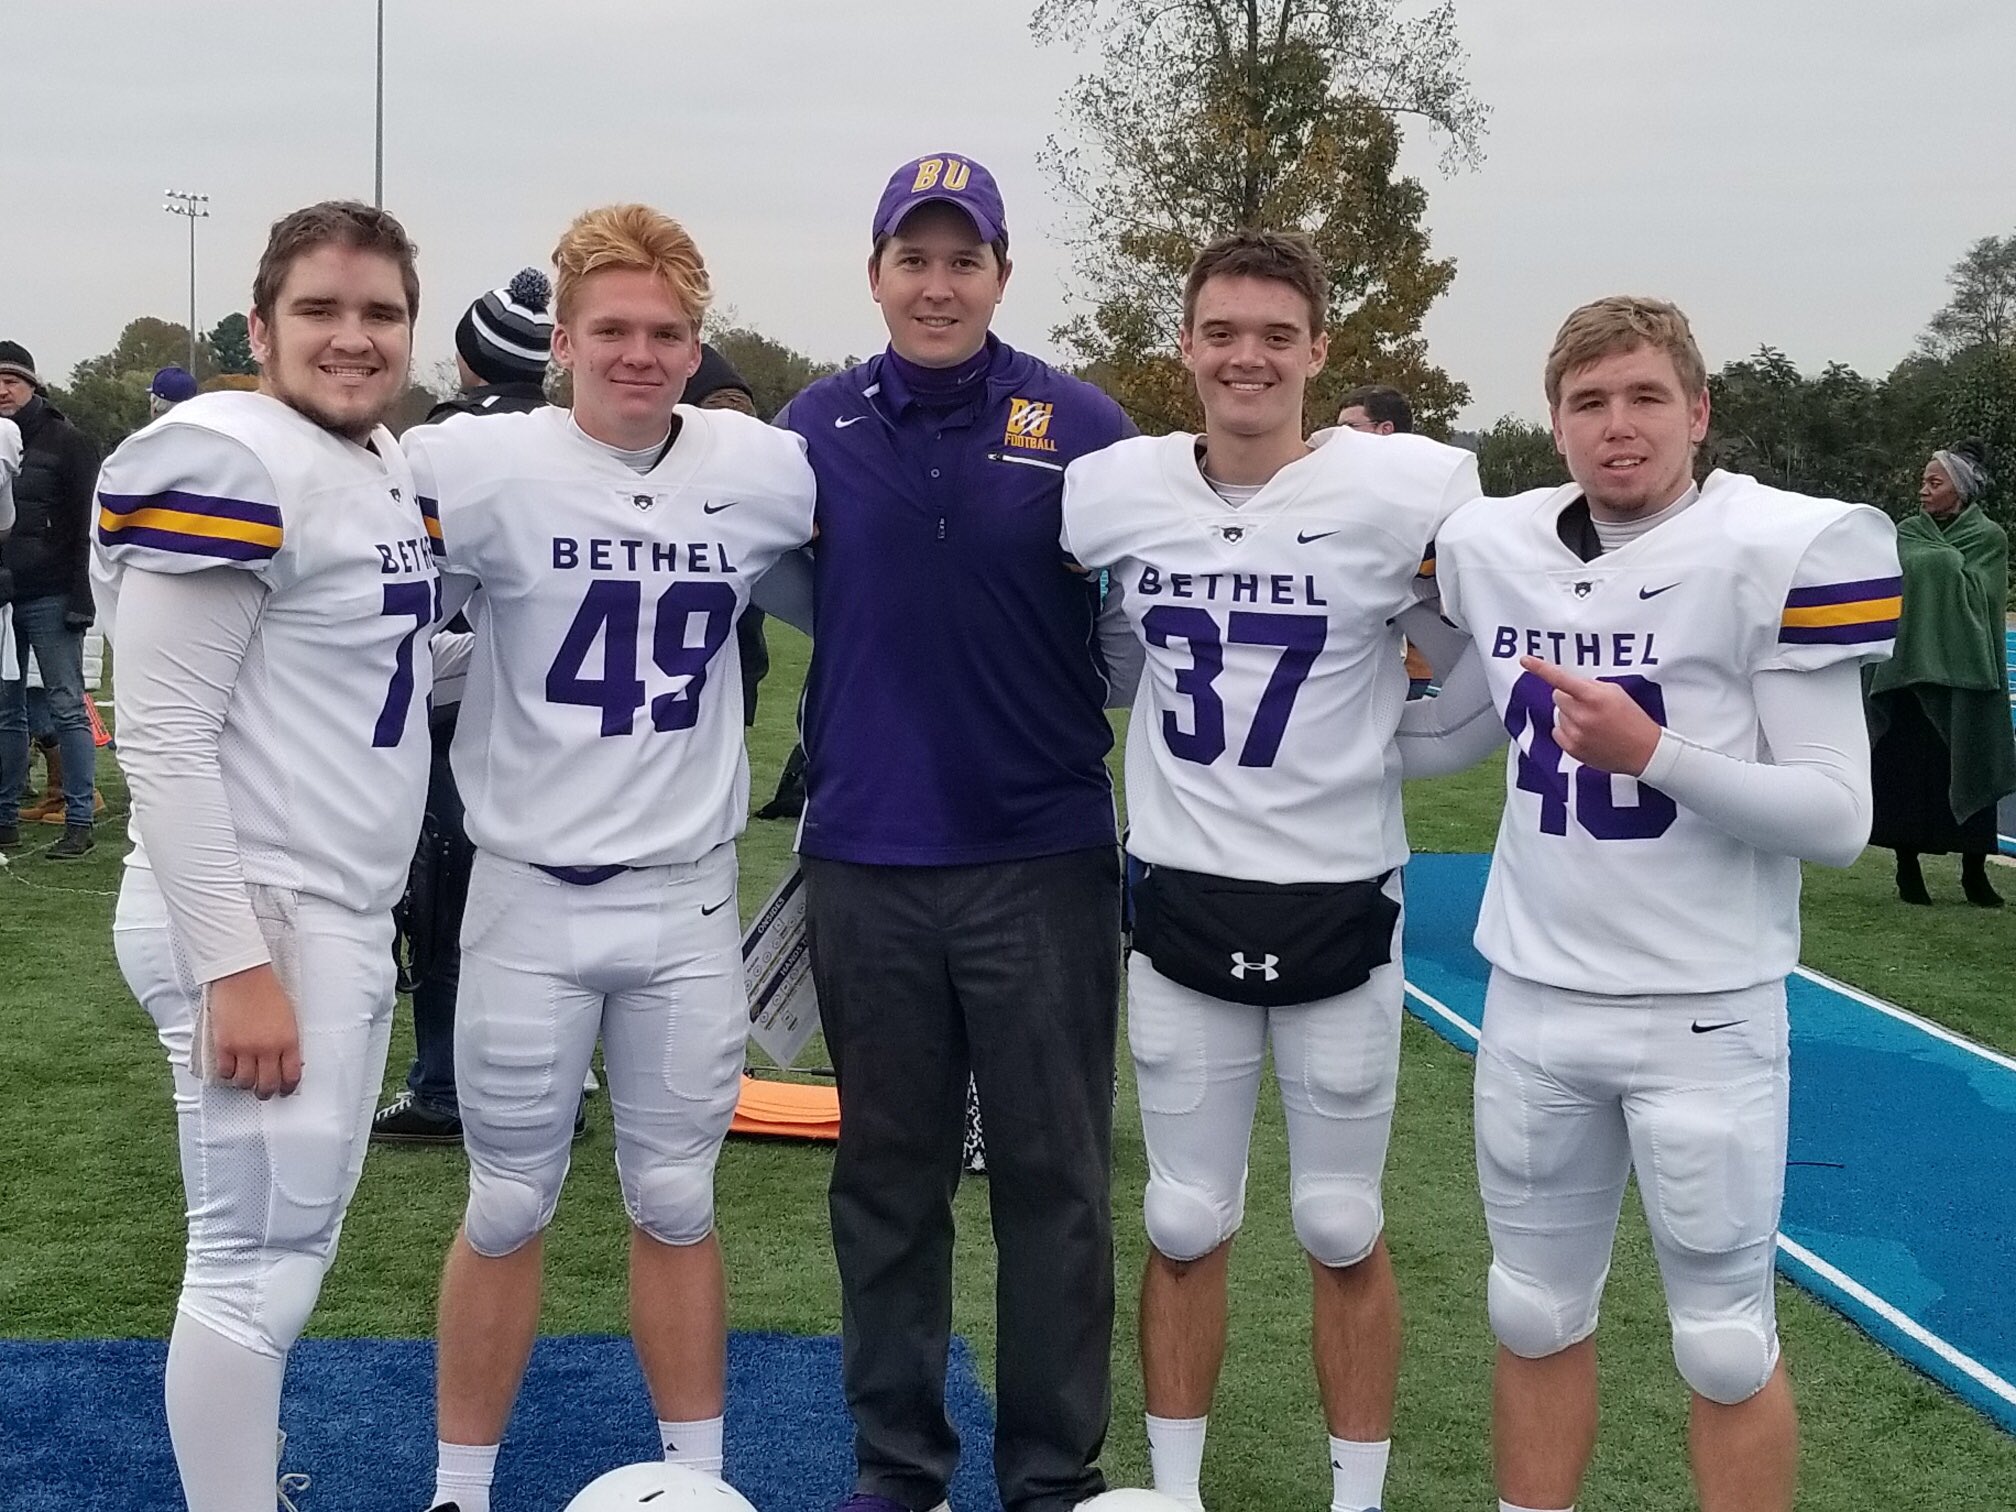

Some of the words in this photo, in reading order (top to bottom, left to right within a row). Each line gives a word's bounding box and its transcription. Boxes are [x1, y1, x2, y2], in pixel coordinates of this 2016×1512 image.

[911, 157, 972, 193] BU
[1004, 432, 1058, 452] FOOTBALL
[375, 535, 437, 574] BETH
[553, 537, 738, 573] BETHEL
[1138, 566, 1328, 607] BETHEL
[371, 576, 444, 747] 7
[545, 579, 738, 738] 49
[1492, 625, 1660, 667] BETHEL
[1141, 604, 1329, 768] 37
[757, 897, 785, 934] ONSIDES
[780, 944, 803, 976] HANDS
